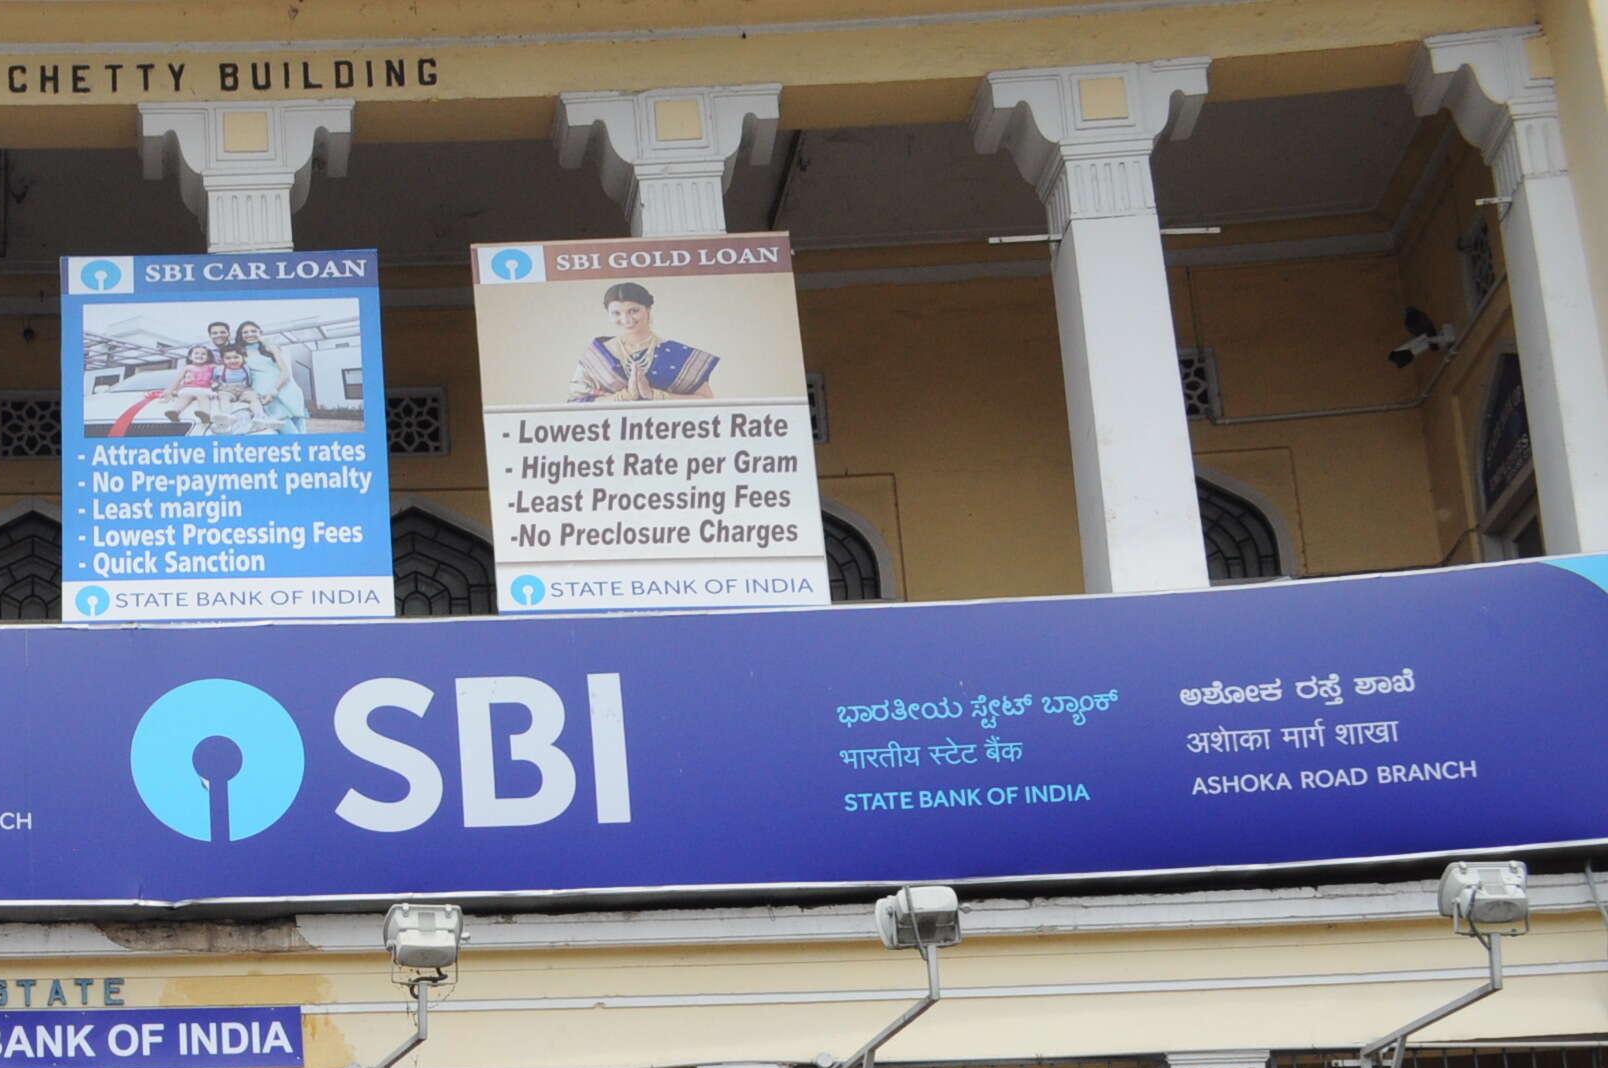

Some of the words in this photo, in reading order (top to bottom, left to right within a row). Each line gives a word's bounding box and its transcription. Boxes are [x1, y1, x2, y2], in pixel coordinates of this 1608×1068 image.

[8, 63, 186, 93] CHETTY
[218, 58, 438, 91] BUILDING
[145, 264, 195, 282] SBI
[203, 262, 270, 281] CAR
[276, 259, 367, 278] LOAN
[556, 254, 600, 271] SBI
[608, 251, 691, 269] GOLD
[698, 248, 779, 265] LOAN
[519, 419, 610, 444] Lowest
[620, 416, 721, 441] Interest
[730, 413, 788, 438] Rate
[92, 442, 205, 466] Attractive
[213, 441, 300, 463] interest
[309, 442, 366, 462] rates
[521, 455, 614, 484] Highest
[623, 453, 678, 476] Rate
[686, 454, 726, 480] per
[734, 451, 798, 472] Gram
[93, 472, 124, 493] No
[132, 469, 278, 496] Pre-payment
[285, 466, 372, 494] penalty
[93, 498, 153, 519] Least
[161, 496, 242, 522] margin
[592, 486, 725, 514] Processing
[735, 485, 791, 508] Fees
[93, 526, 175, 547] Lowest
[183, 522, 305, 549] Processing
[313, 522, 363, 543] Fees
[560, 522, 690, 546] Preclosure
[700, 519, 798, 548] Charges
[93, 552, 157, 577] Quick
[165, 549, 265, 572] Sanction
[116, 592, 188, 608] STATE
[197, 592, 263, 607] BANK
[271, 591, 304, 606] OF
[312, 589, 380, 604] INDIA
[551, 582, 624, 597] STATE
[632, 579, 696, 595] BANK
[704, 579, 737, 594] OF
[746, 578, 813, 593] INDIA
[334, 673, 631, 832] SBI
[1192, 772, 1292, 794] ASHOKA
[1301, 768, 1368, 788] ROAD
[1377, 760, 1477, 783] BRANCH
[844, 791, 914, 812] STATE
[920, 788, 982, 808] BANK
[987, 787, 1018, 805] OF
[1025, 784, 1091, 803] INDIA
[108, 1023, 165, 1057] OF
[179, 1021, 293, 1055] INDIA
